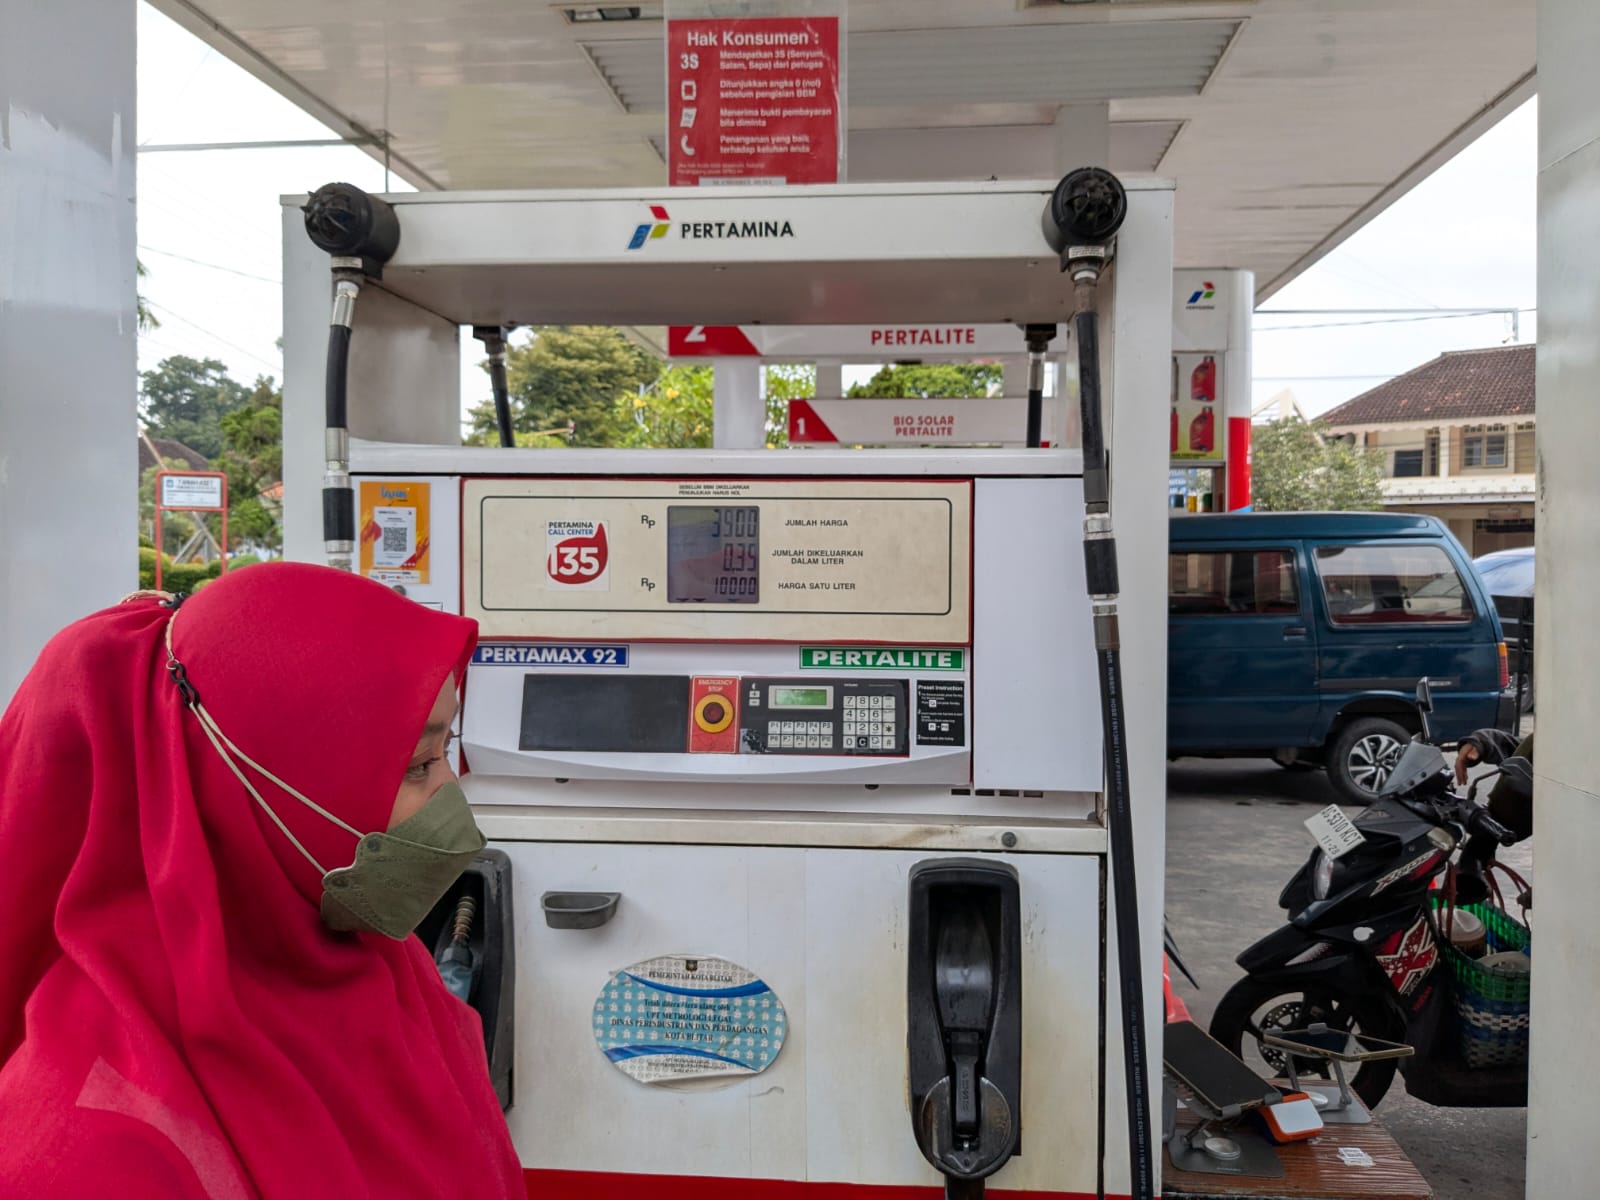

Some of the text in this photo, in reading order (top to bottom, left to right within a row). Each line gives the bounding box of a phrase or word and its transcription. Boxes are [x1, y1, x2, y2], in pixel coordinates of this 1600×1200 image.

[687, 32, 718, 46] Hak
[722, 31, 809, 45] Konsumen
[680, 53, 699, 69] 3S
[681, 221, 794, 239] PERTAMINA
[871, 328, 976, 345] PERTALITE
[796, 418, 806, 435] 1
[893, 416, 955, 426] BIO SOLAR
[895, 426, 953, 437] PERTALITE
[548, 521, 593, 529] PERTAMINA
[641, 514, 656, 529] Rp
[711, 508, 758, 538] 3500
[785, 519, 848, 527] JUMLAH HARGA
[772, 549, 863, 557] JUMLAH DIKELUARKAN
[549, 546, 600, 576] 135
[791, 557, 844, 565] DALAM LITER
[641, 577, 656, 592] Rp
[714, 576, 757, 596] 10000
[778, 582, 856, 590] HARGA SATU LITER
[481, 647, 617, 664] PERTAMAX 92
[812, 650, 952, 667] PERTALITE
[611, 1018, 633, 1026] DINAS
[665, 1031, 685, 1039] KOTA
